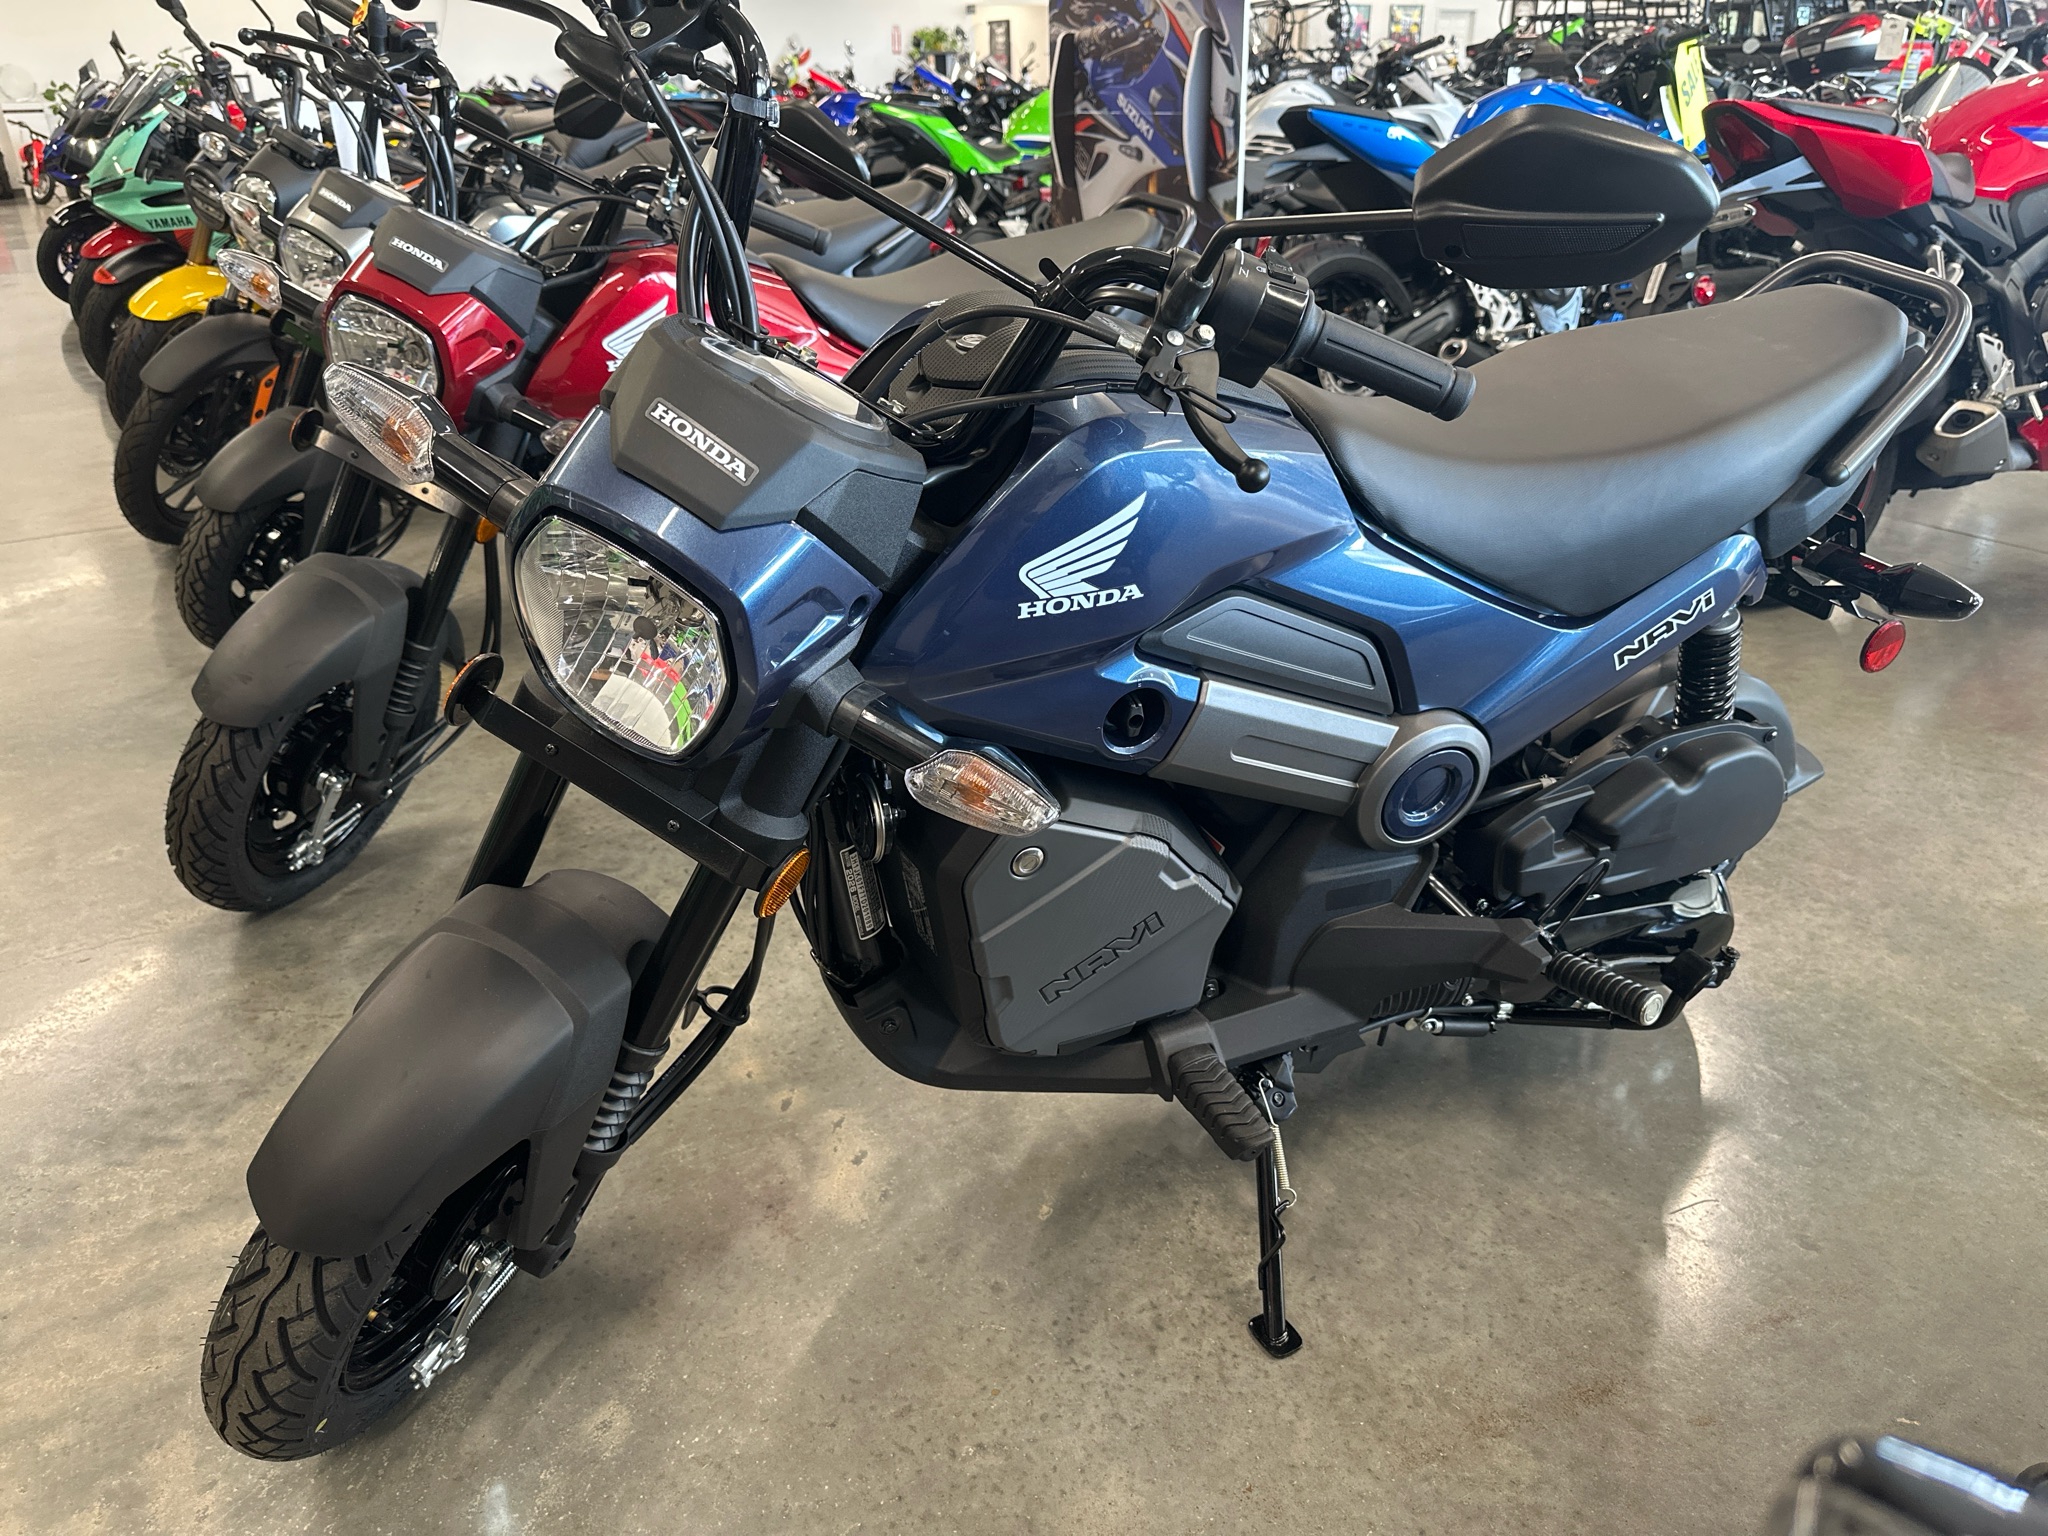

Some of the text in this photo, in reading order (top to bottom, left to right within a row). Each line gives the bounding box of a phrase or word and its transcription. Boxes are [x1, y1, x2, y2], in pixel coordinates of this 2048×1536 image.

[1117, 92, 1154, 141] SUZUKI
[318, 187, 353, 213] HONDA
[145, 215, 194, 229] YAMAHA
[391, 237, 446, 271] HONDA
[650, 402, 746, 482] HONDA
[1017, 583, 1144, 619] HONDA
[845, 868, 857, 893] 2026
